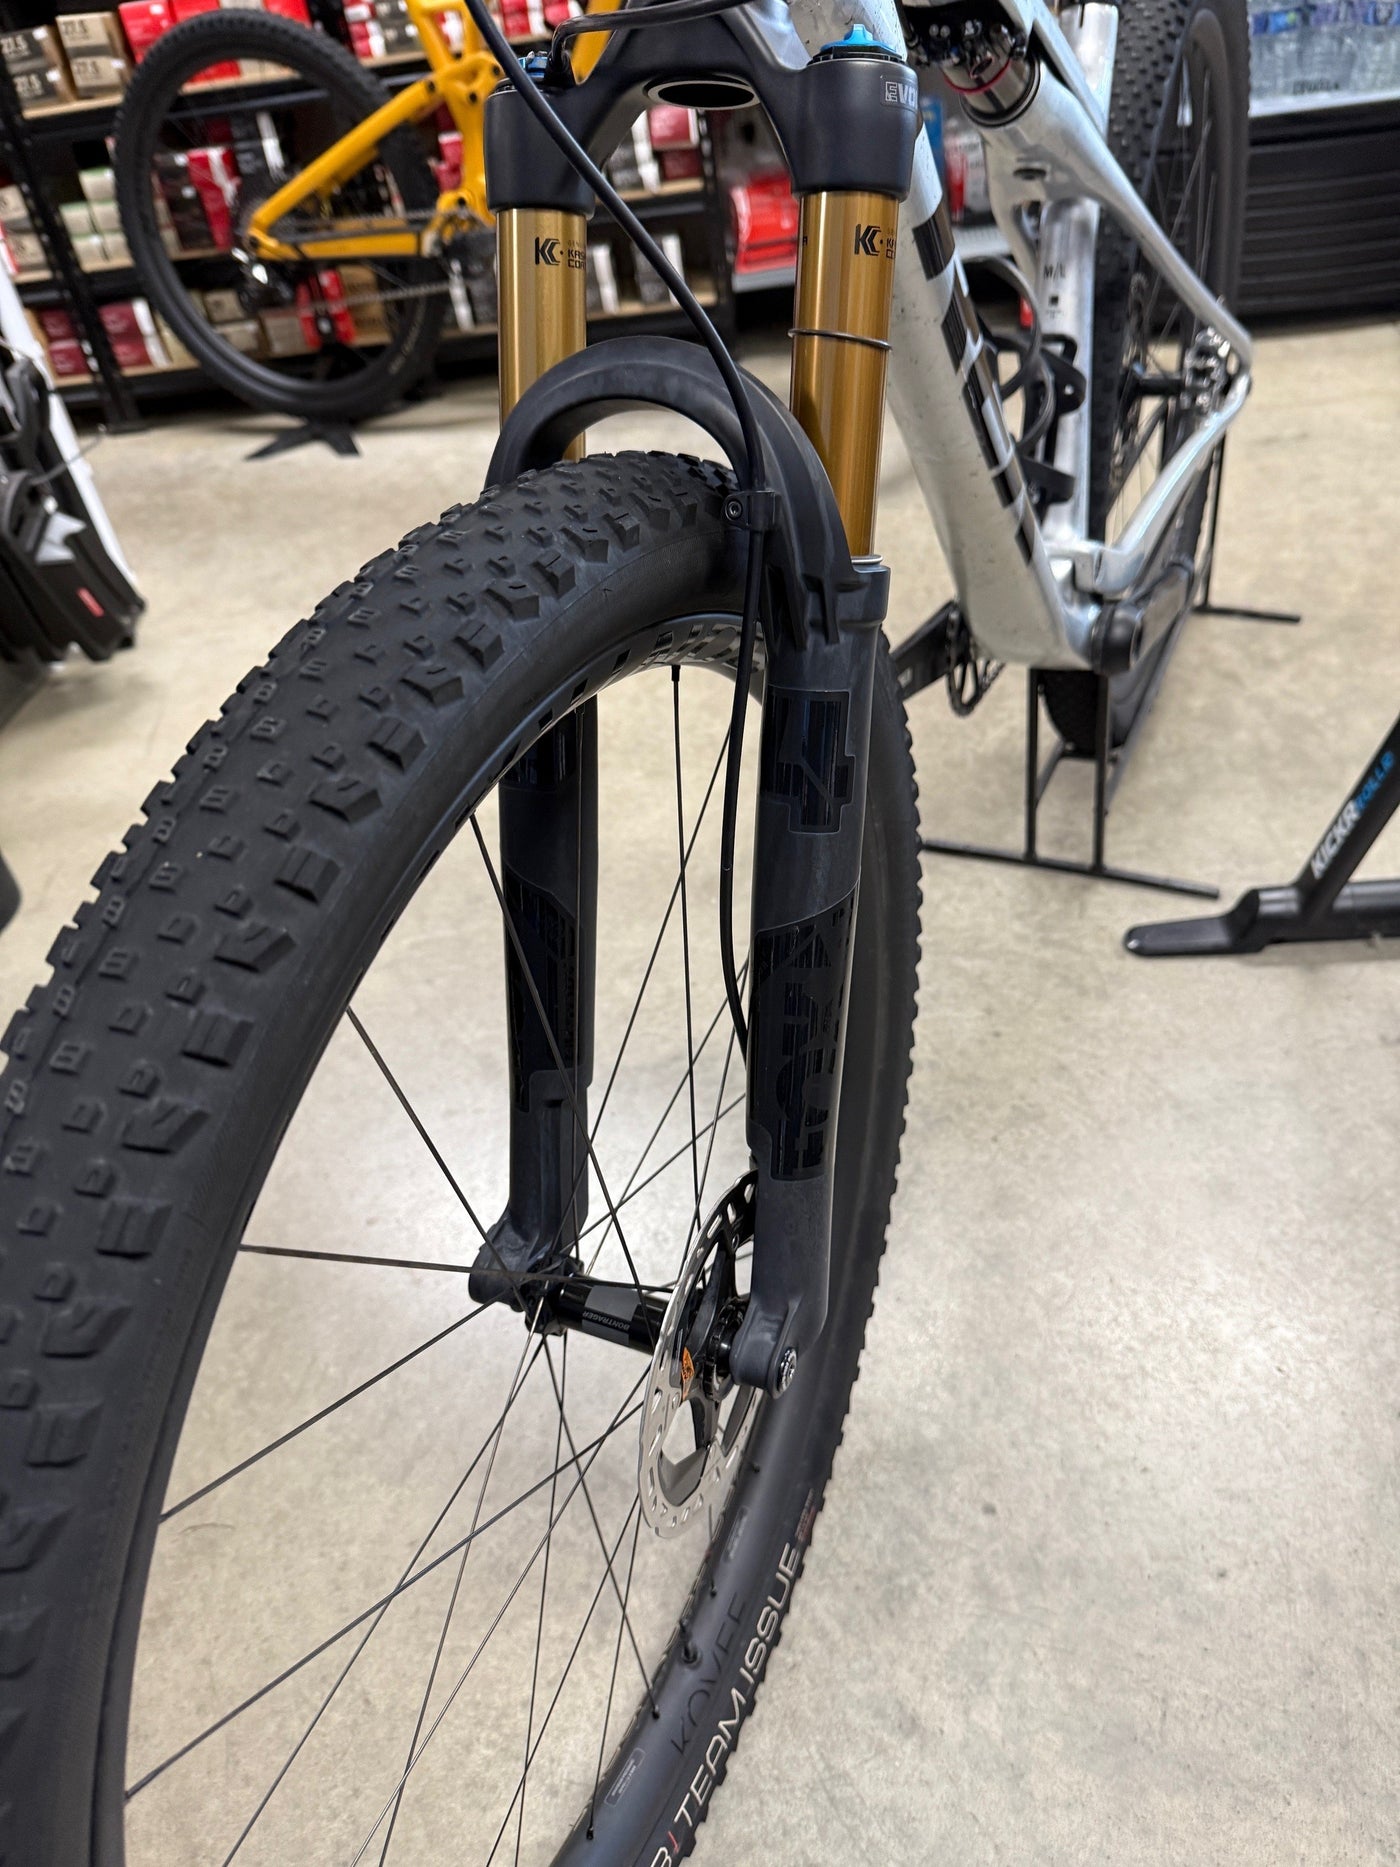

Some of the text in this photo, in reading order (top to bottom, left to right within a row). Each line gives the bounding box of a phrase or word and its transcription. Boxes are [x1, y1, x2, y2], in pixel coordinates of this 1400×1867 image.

[1310, 799, 1361, 881] KICKR
[582, 1310, 631, 1332] BONTRAGER
[674, 1687, 747, 1828] TEAM
[740, 1542, 802, 1684] ISSUE
